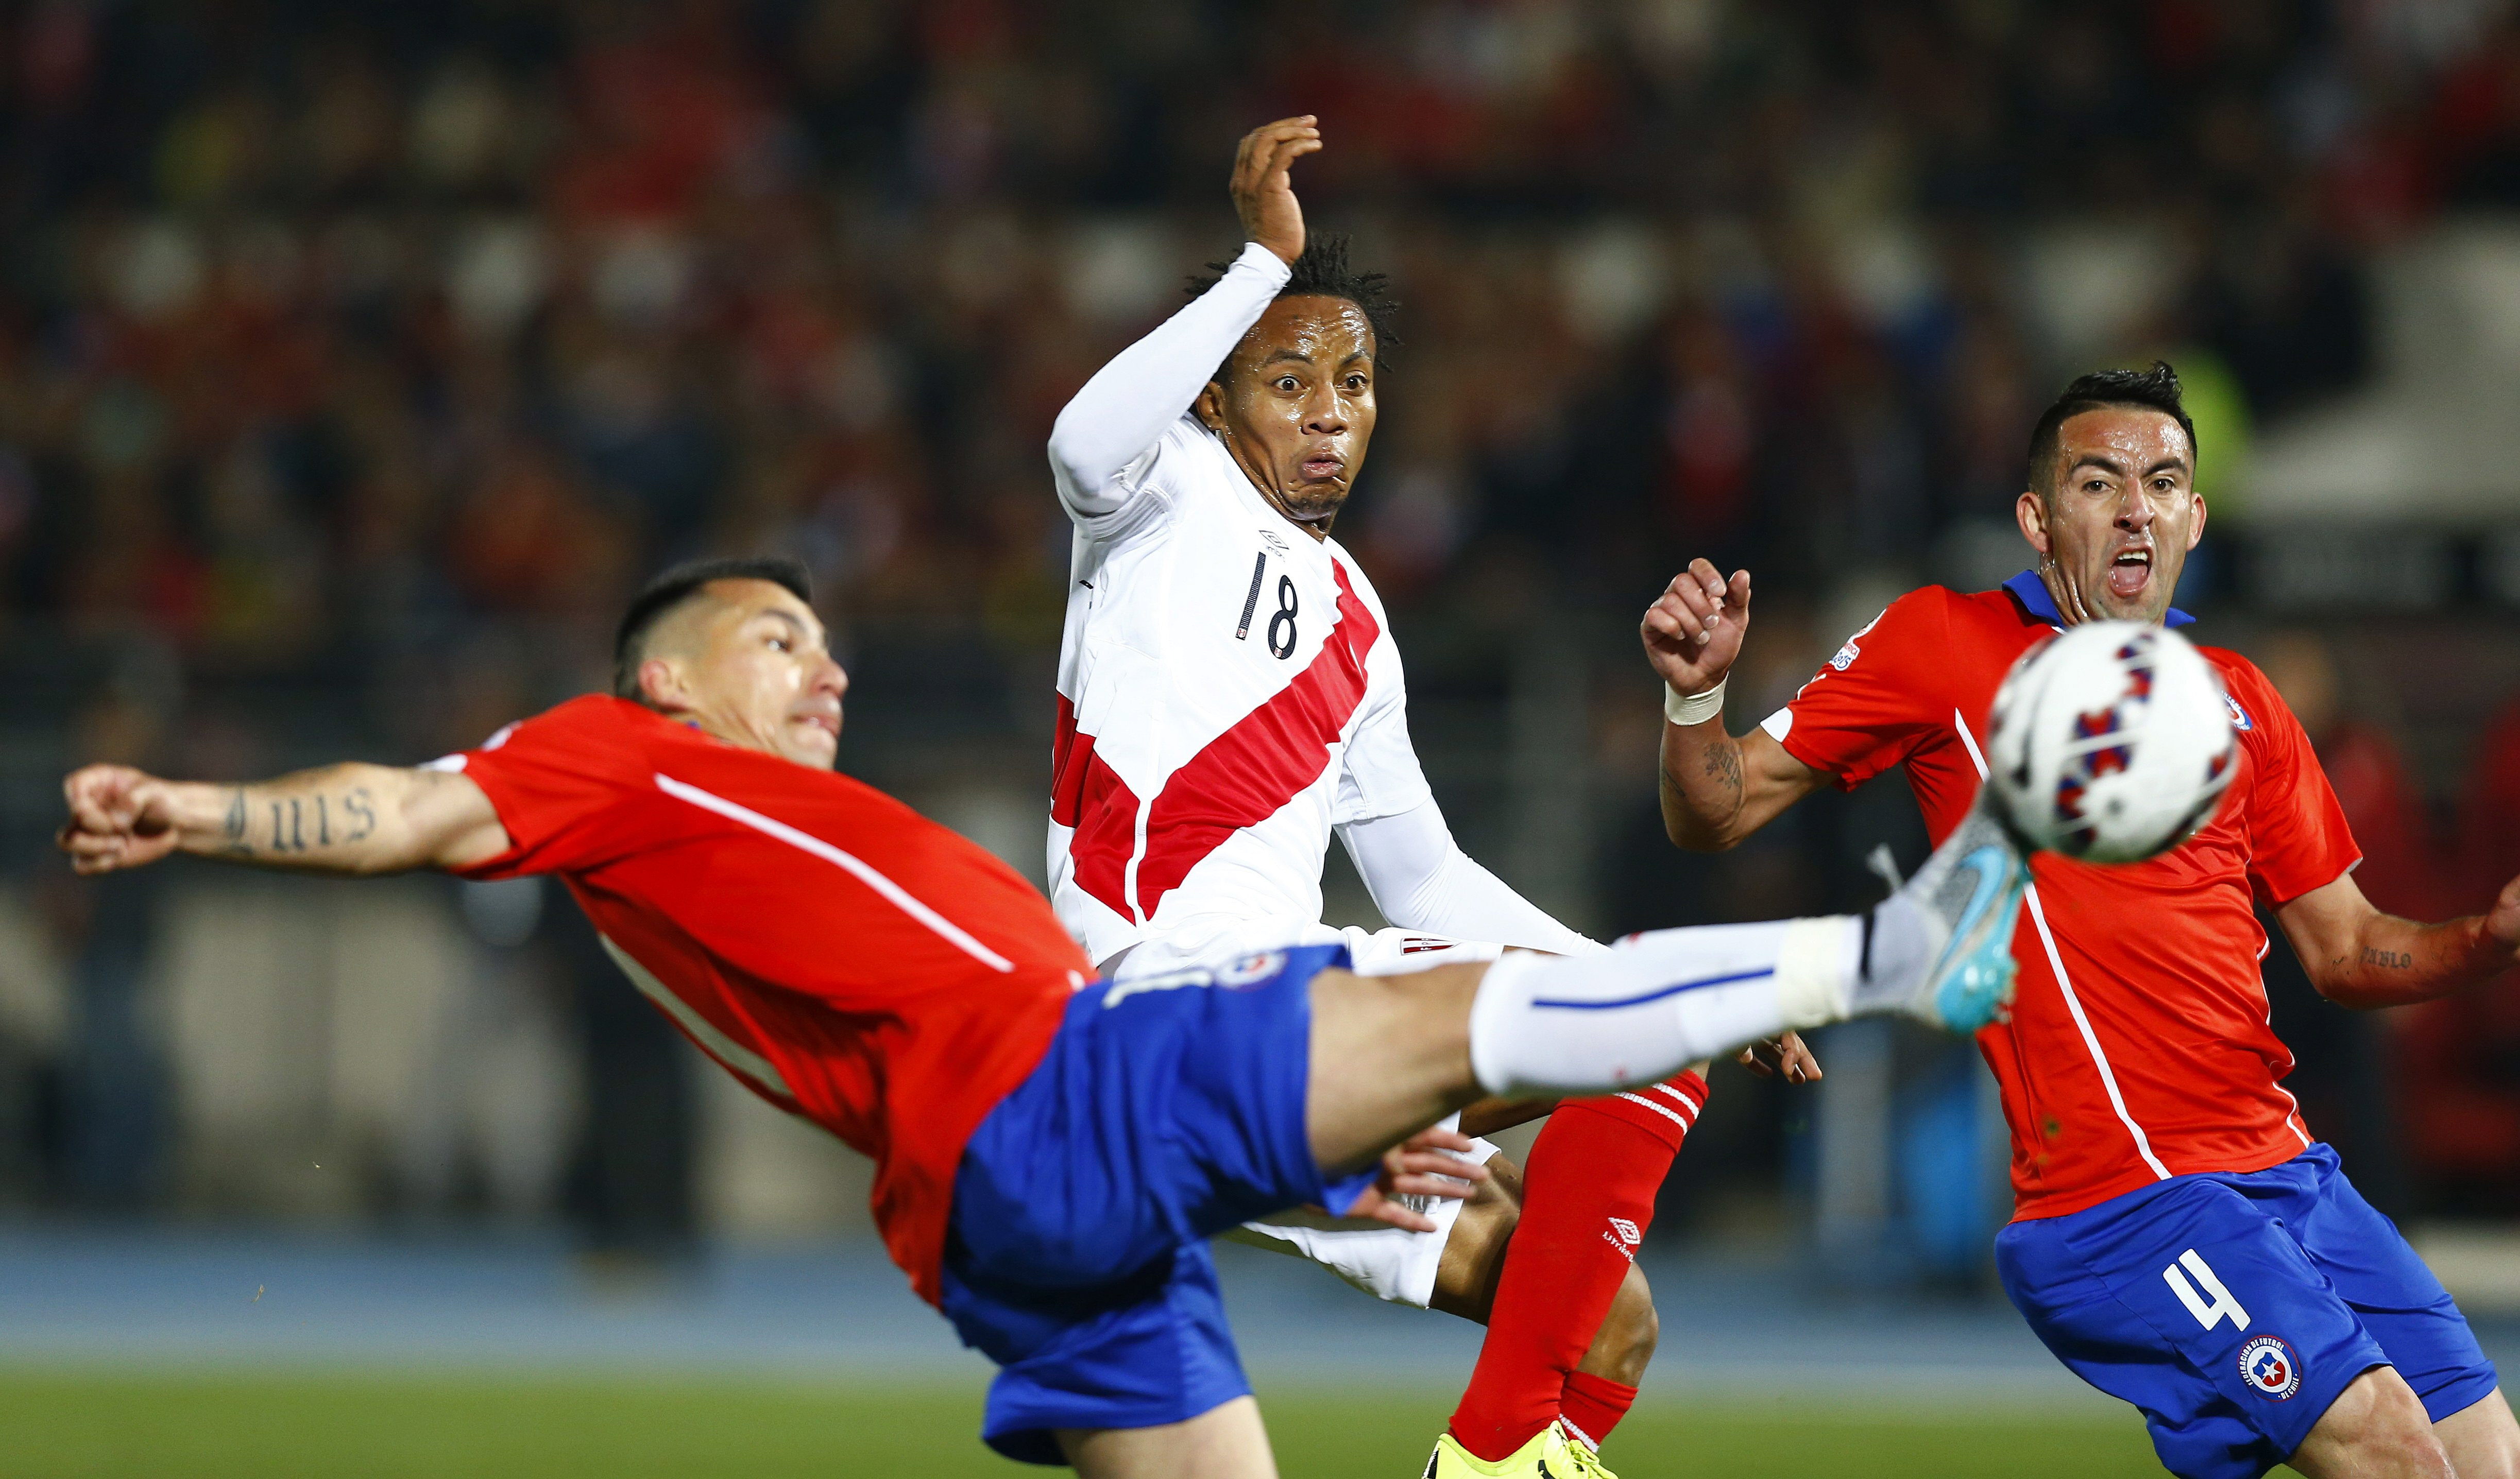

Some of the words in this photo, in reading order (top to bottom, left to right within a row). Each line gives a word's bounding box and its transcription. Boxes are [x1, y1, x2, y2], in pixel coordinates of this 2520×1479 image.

[1235, 551, 1299, 660] 18
[2162, 1248, 2252, 1332] 4
[2239, 1345, 2253, 1386] FEDERACION
[2250, 1339, 2260, 1348] DE
[2259, 1337, 2285, 1351] FUTBOL
[2280, 1390, 2290, 1399] DE
[2288, 1377, 2300, 1395] CHILE
